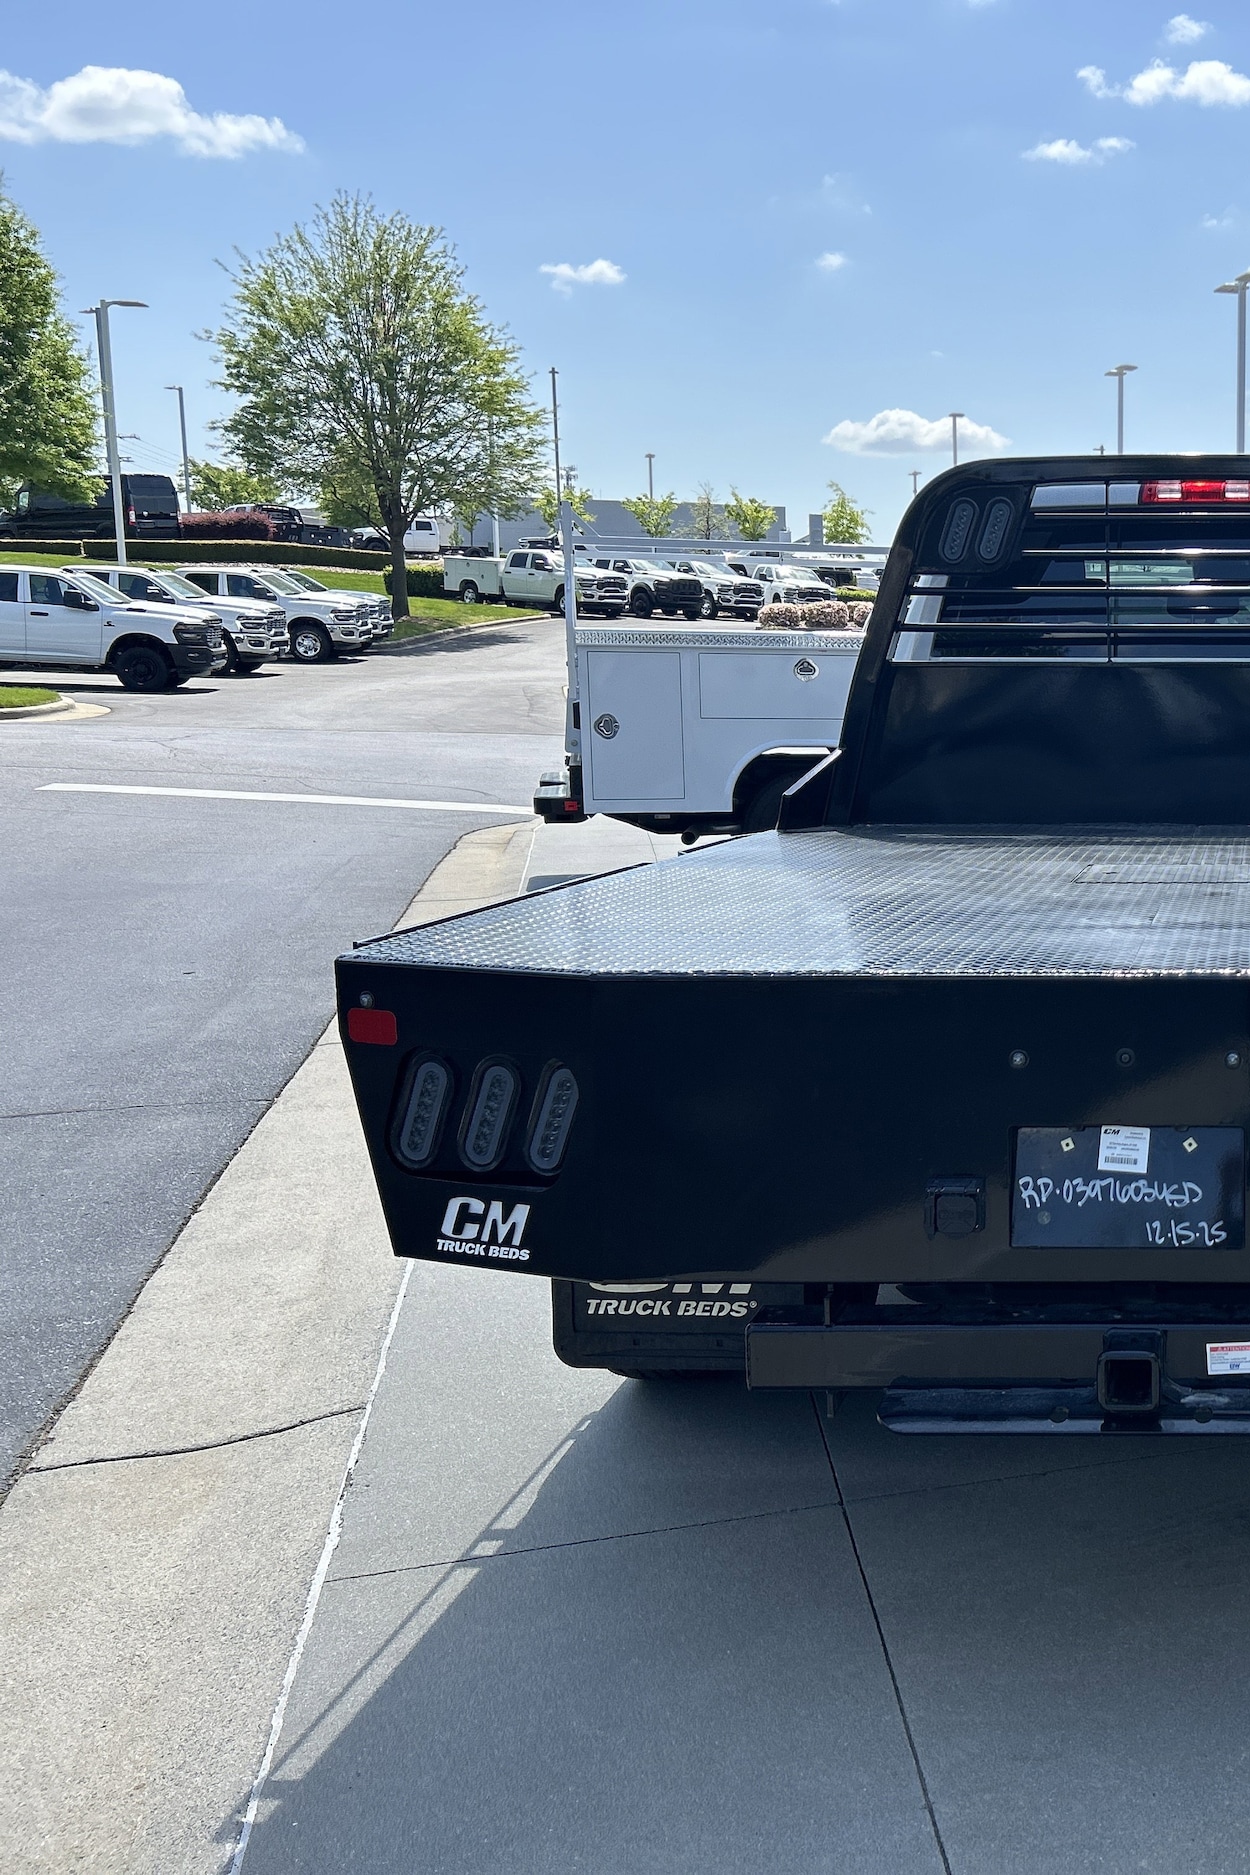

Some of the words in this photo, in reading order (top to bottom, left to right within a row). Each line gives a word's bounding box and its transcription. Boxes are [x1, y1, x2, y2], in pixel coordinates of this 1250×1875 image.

[1103, 1127, 1121, 1136] CM
[440, 1196, 531, 1247] CM
[436, 1238, 487, 1256] TRUCK
[487, 1246, 531, 1262] BEDS
[586, 1299, 673, 1317] TRUCK
